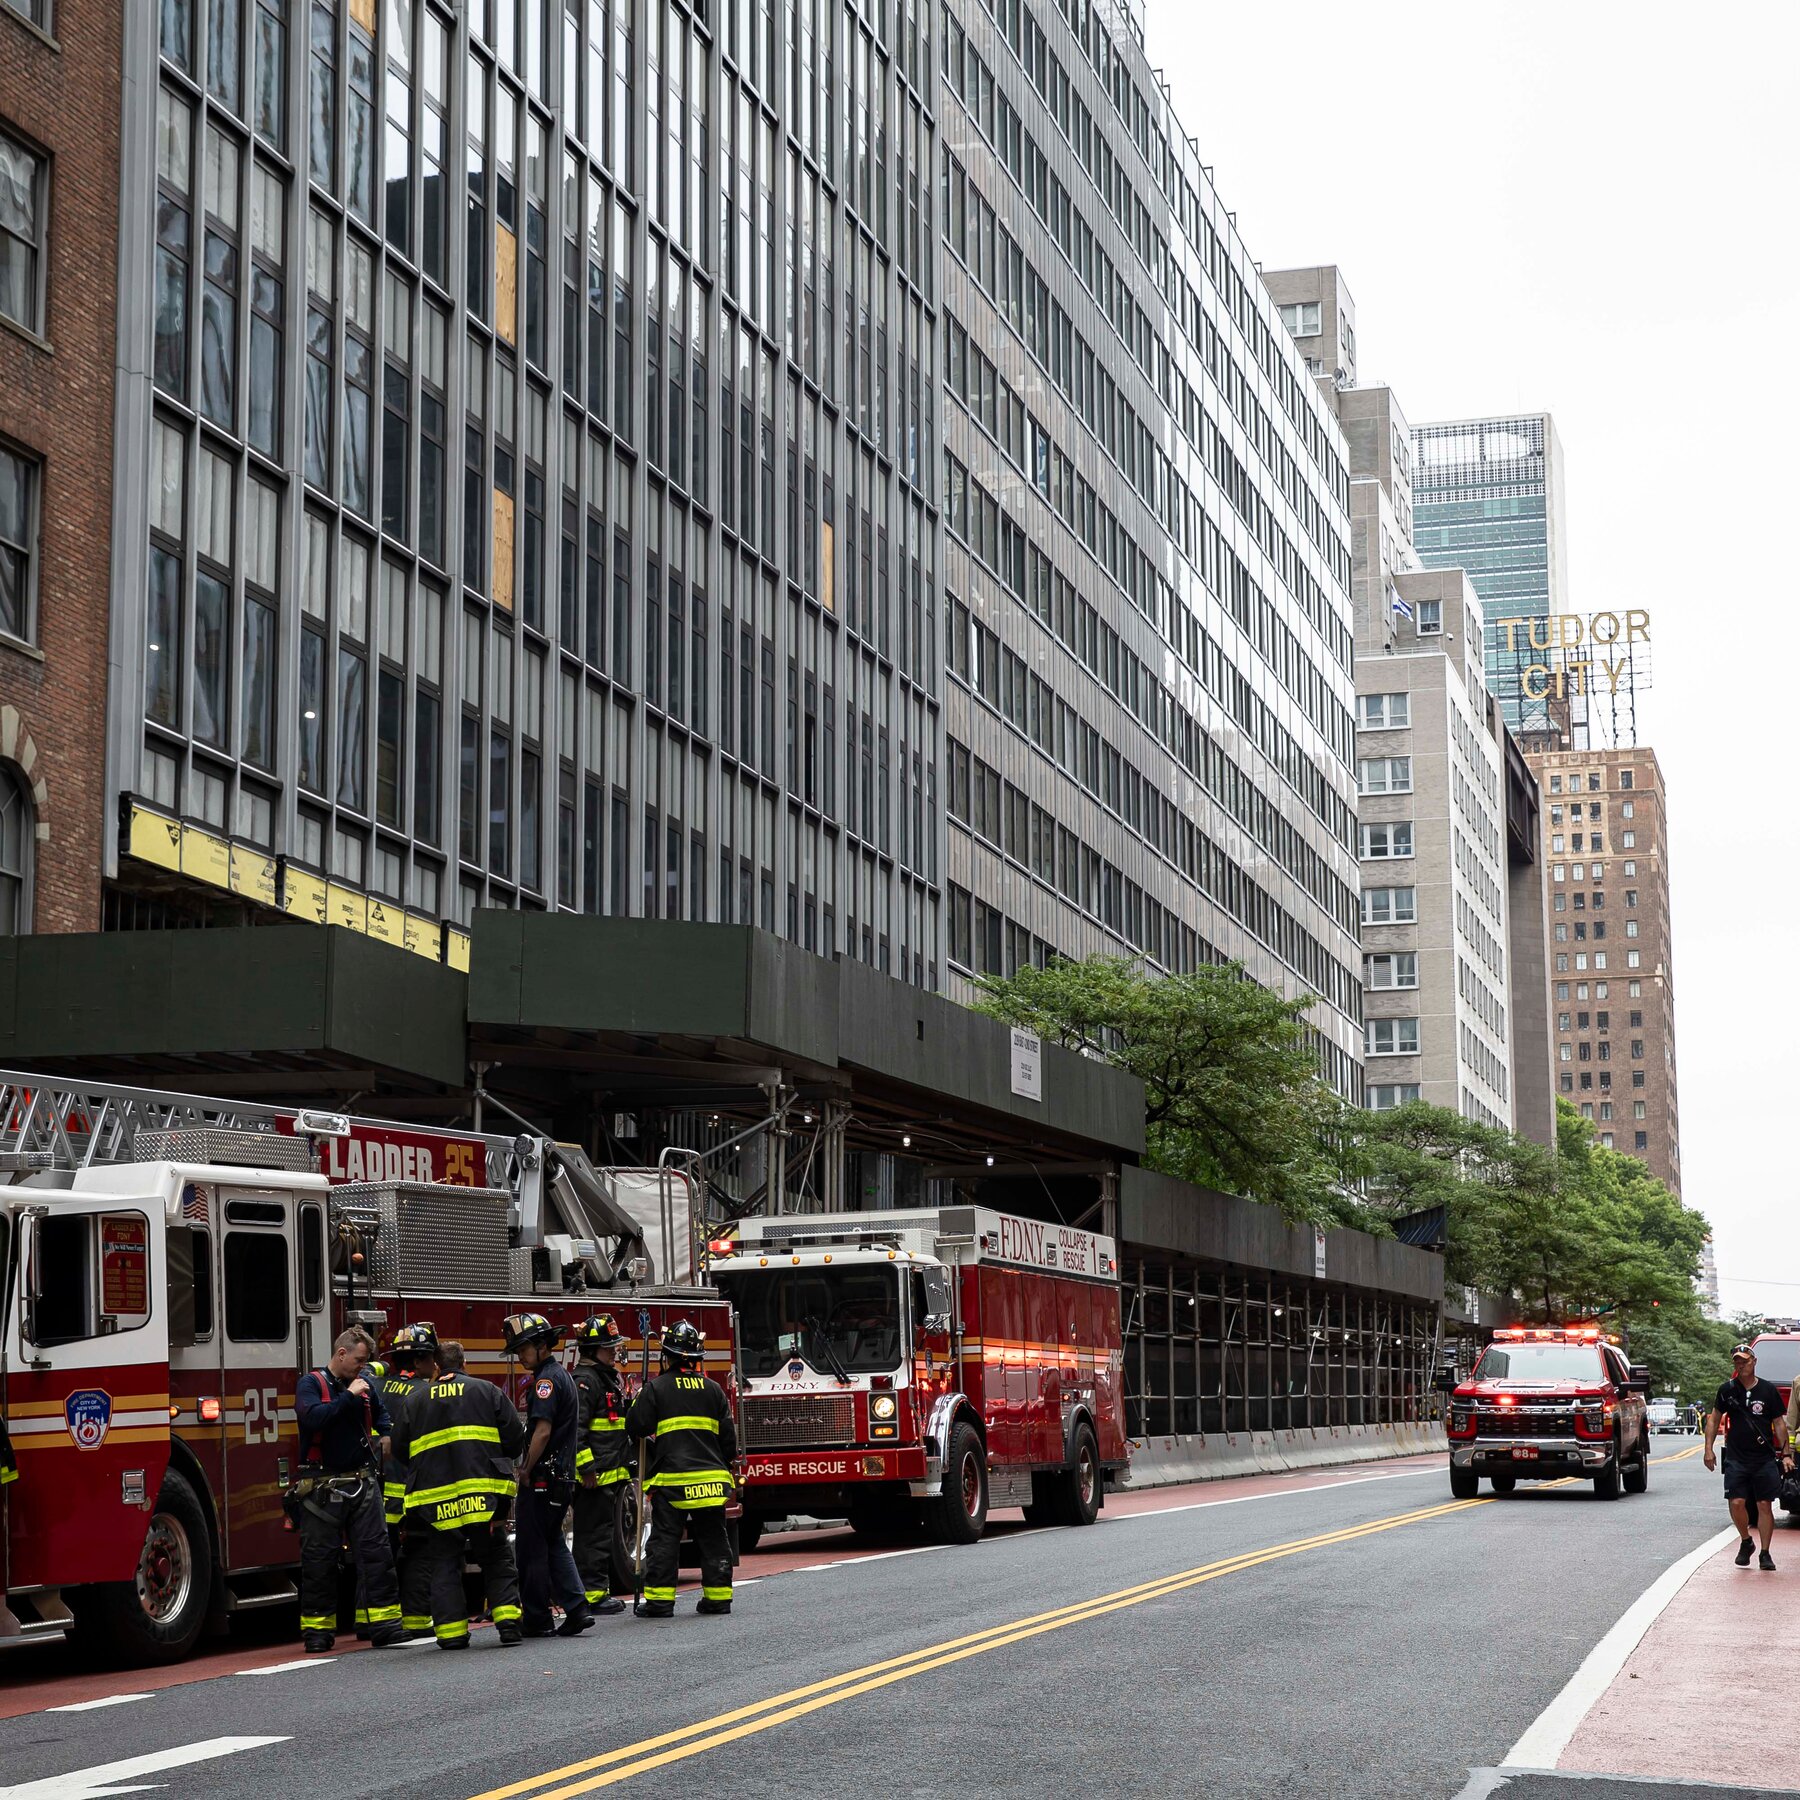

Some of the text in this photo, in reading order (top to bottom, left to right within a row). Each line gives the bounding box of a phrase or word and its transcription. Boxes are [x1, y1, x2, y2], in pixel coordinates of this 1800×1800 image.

[1497, 609, 1650, 652] TUDOR
[1522, 658, 1626, 699] CITY
[329, 1137, 474, 1187] LADDER 25
[1058, 1229, 1088, 1252] COLLAPSE
[1063, 1251, 1086, 1272] RESCUE
[1090, 1236, 1097, 1275] 1
[383, 1380, 415, 1396] FDNY
[430, 1382, 465, 1400] FDNY
[675, 1377, 705, 1390] FDNY
[244, 1387, 279, 1445] 25
[762, 1416, 823, 1425] MACK
[1521, 1449, 1529, 1459] 8
[739, 1460, 861, 1477] LAPSE RESCUE 1
[684, 1483, 724, 1499] BODNAR
[437, 1495, 487, 1520] ARMRONG
